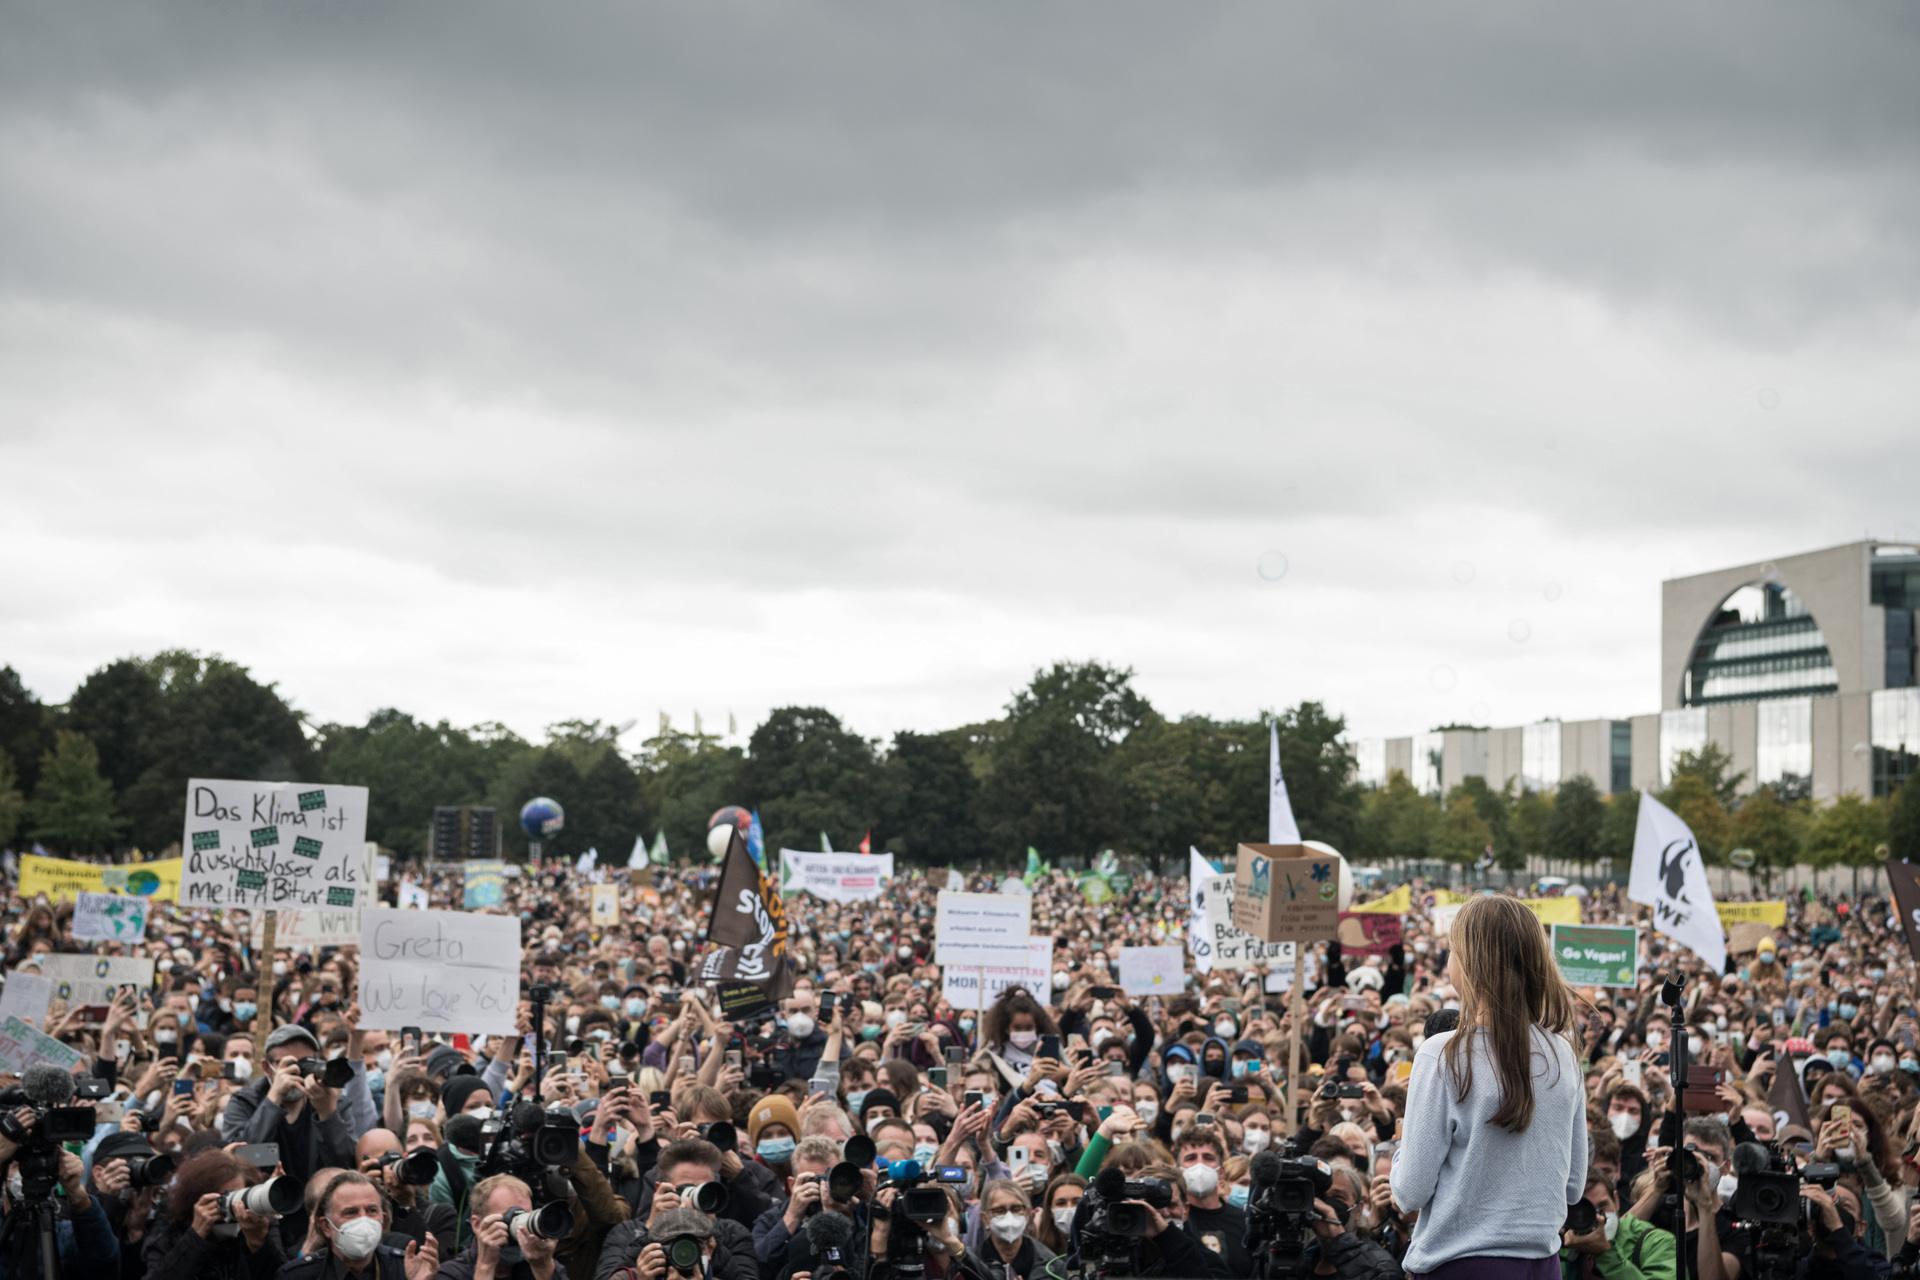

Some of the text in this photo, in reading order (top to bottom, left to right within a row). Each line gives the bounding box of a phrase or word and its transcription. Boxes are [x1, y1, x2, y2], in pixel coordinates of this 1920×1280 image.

[194, 786, 349, 831] Das Klima ist
[324, 854, 356, 883] als
[188, 873, 247, 904] mein
[1656, 897, 1692, 929] WF
[374, 919, 464, 962] Greta
[1216, 942, 1240, 960] For
[1245, 938, 1293, 960] Future
[1562, 946, 1627, 964] Go Vegan!
[364, 973, 408, 1013] We
[421, 974, 462, 1013] love
